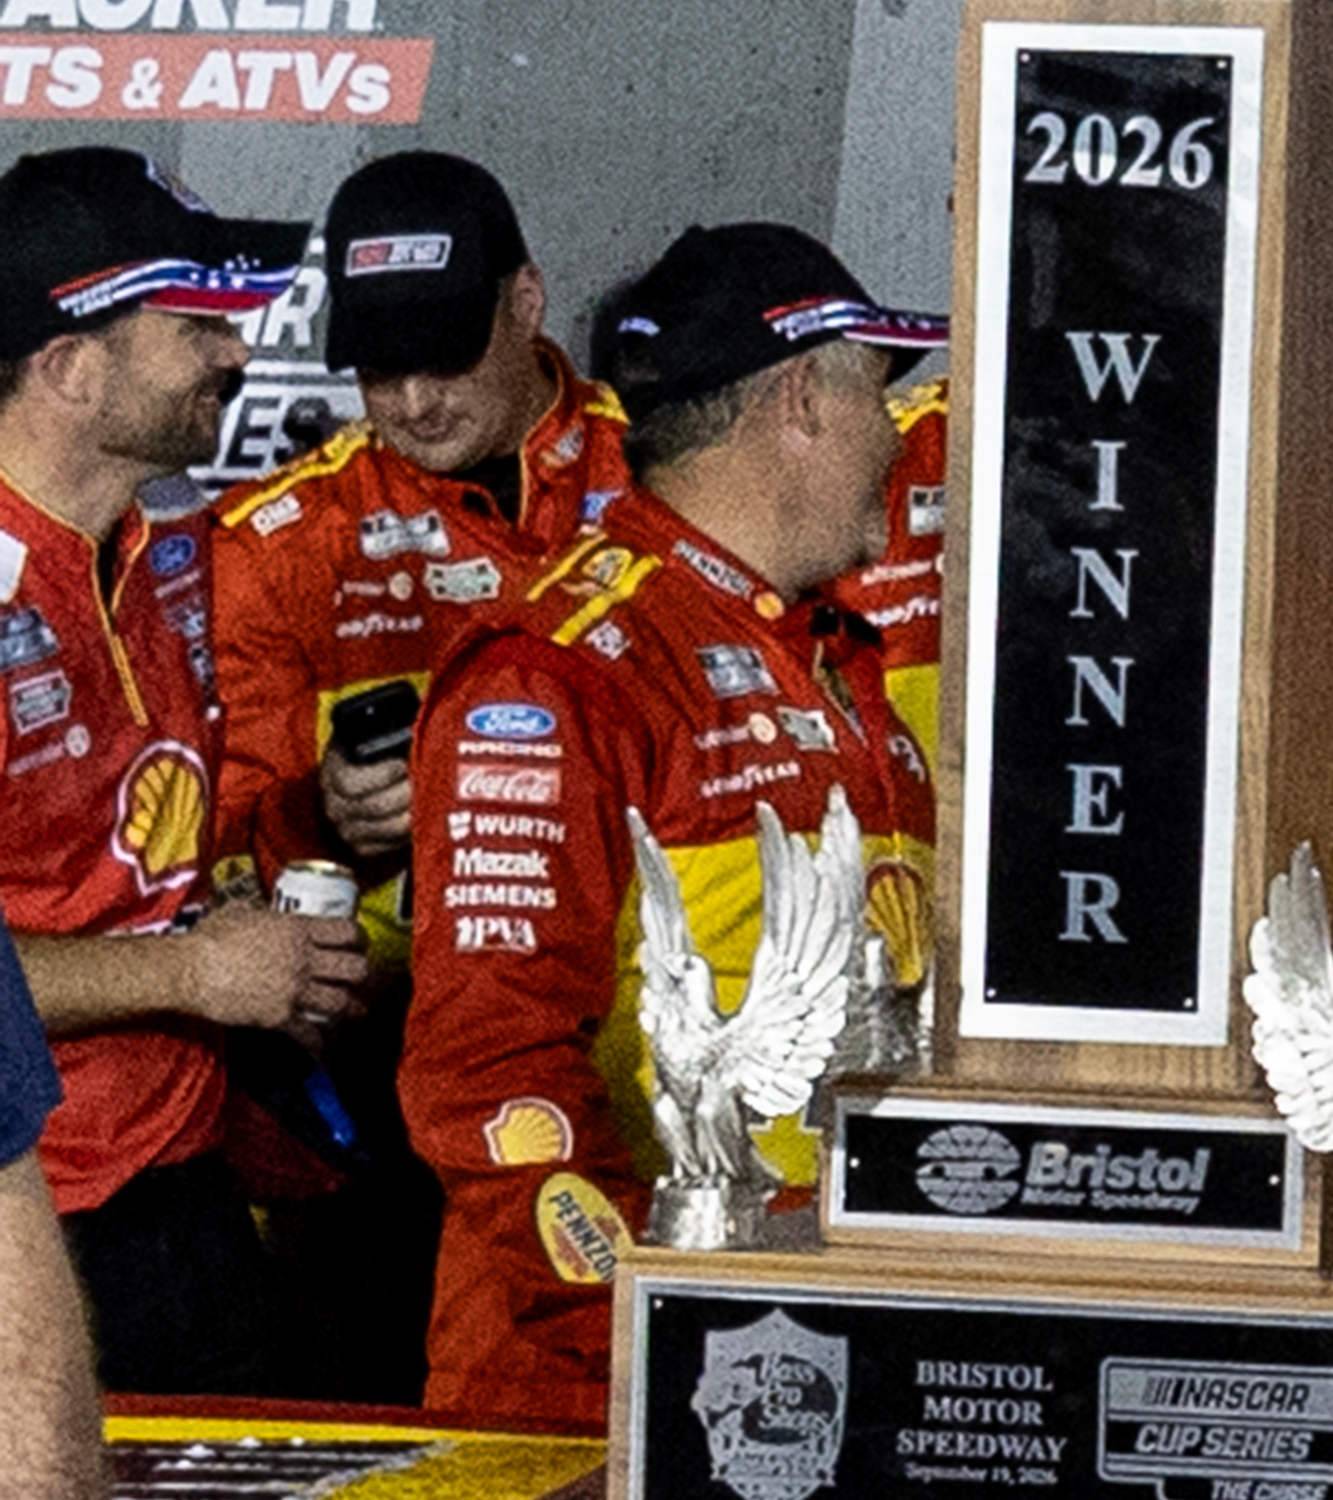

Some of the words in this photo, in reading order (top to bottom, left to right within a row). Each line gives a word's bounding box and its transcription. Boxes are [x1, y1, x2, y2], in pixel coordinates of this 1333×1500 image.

[122, 56, 164, 109] &
[178, 49, 392, 114] ATVs
[1022, 111, 1215, 191] 2026
[1056, 329, 1162, 946] WINNER
[453, 847, 550, 879] Mazak
[444, 883, 557, 910] SIEMENS
[1025, 1141, 1211, 1193] Bristol
[915, 1360, 1054, 1391] BRISTOL
[923, 1395, 1044, 1425] MOTOR
[1183, 1377, 1311, 1413] NASCAR
[896, 1429, 1068, 1462] SPEEDWAY
[1135, 1423, 1201, 1455] CUP
[1200, 1426, 1314, 1460] SERIES
